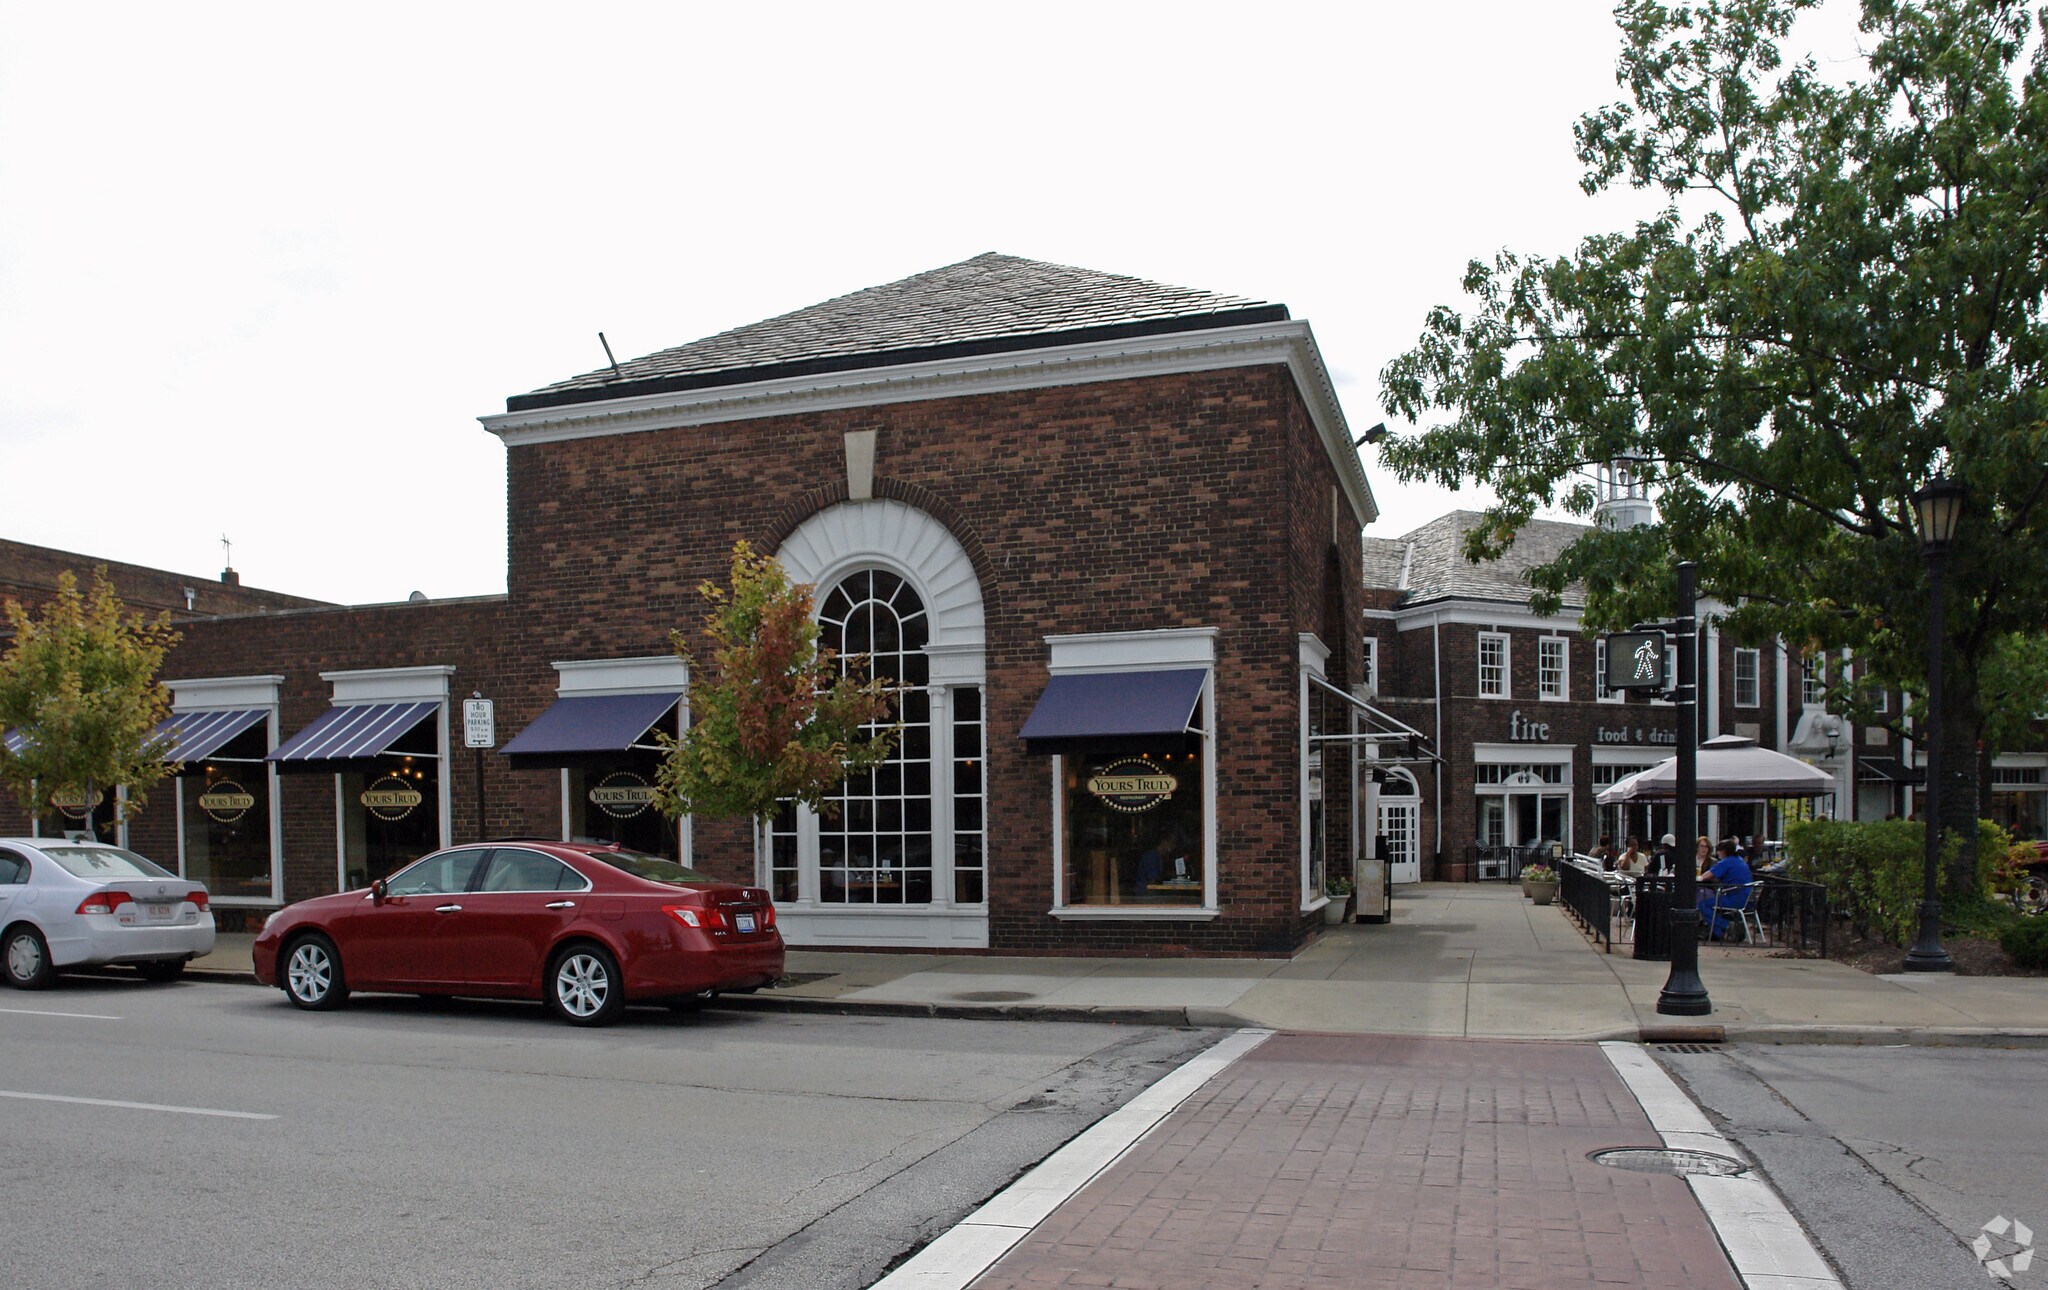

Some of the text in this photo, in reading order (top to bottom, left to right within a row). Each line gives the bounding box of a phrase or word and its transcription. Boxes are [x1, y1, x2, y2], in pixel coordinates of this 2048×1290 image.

[1510, 710, 1549, 740] fire
[1597, 727, 1628, 742] food
[1650, 727, 1677, 743] drin
[1095, 779, 1171, 791] YOURS TRULY
[203, 795, 251, 806] YOURS TRULY
[365, 792, 418, 803] YOURS TRULY
[593, 789, 652, 801] YOURS TRUL
